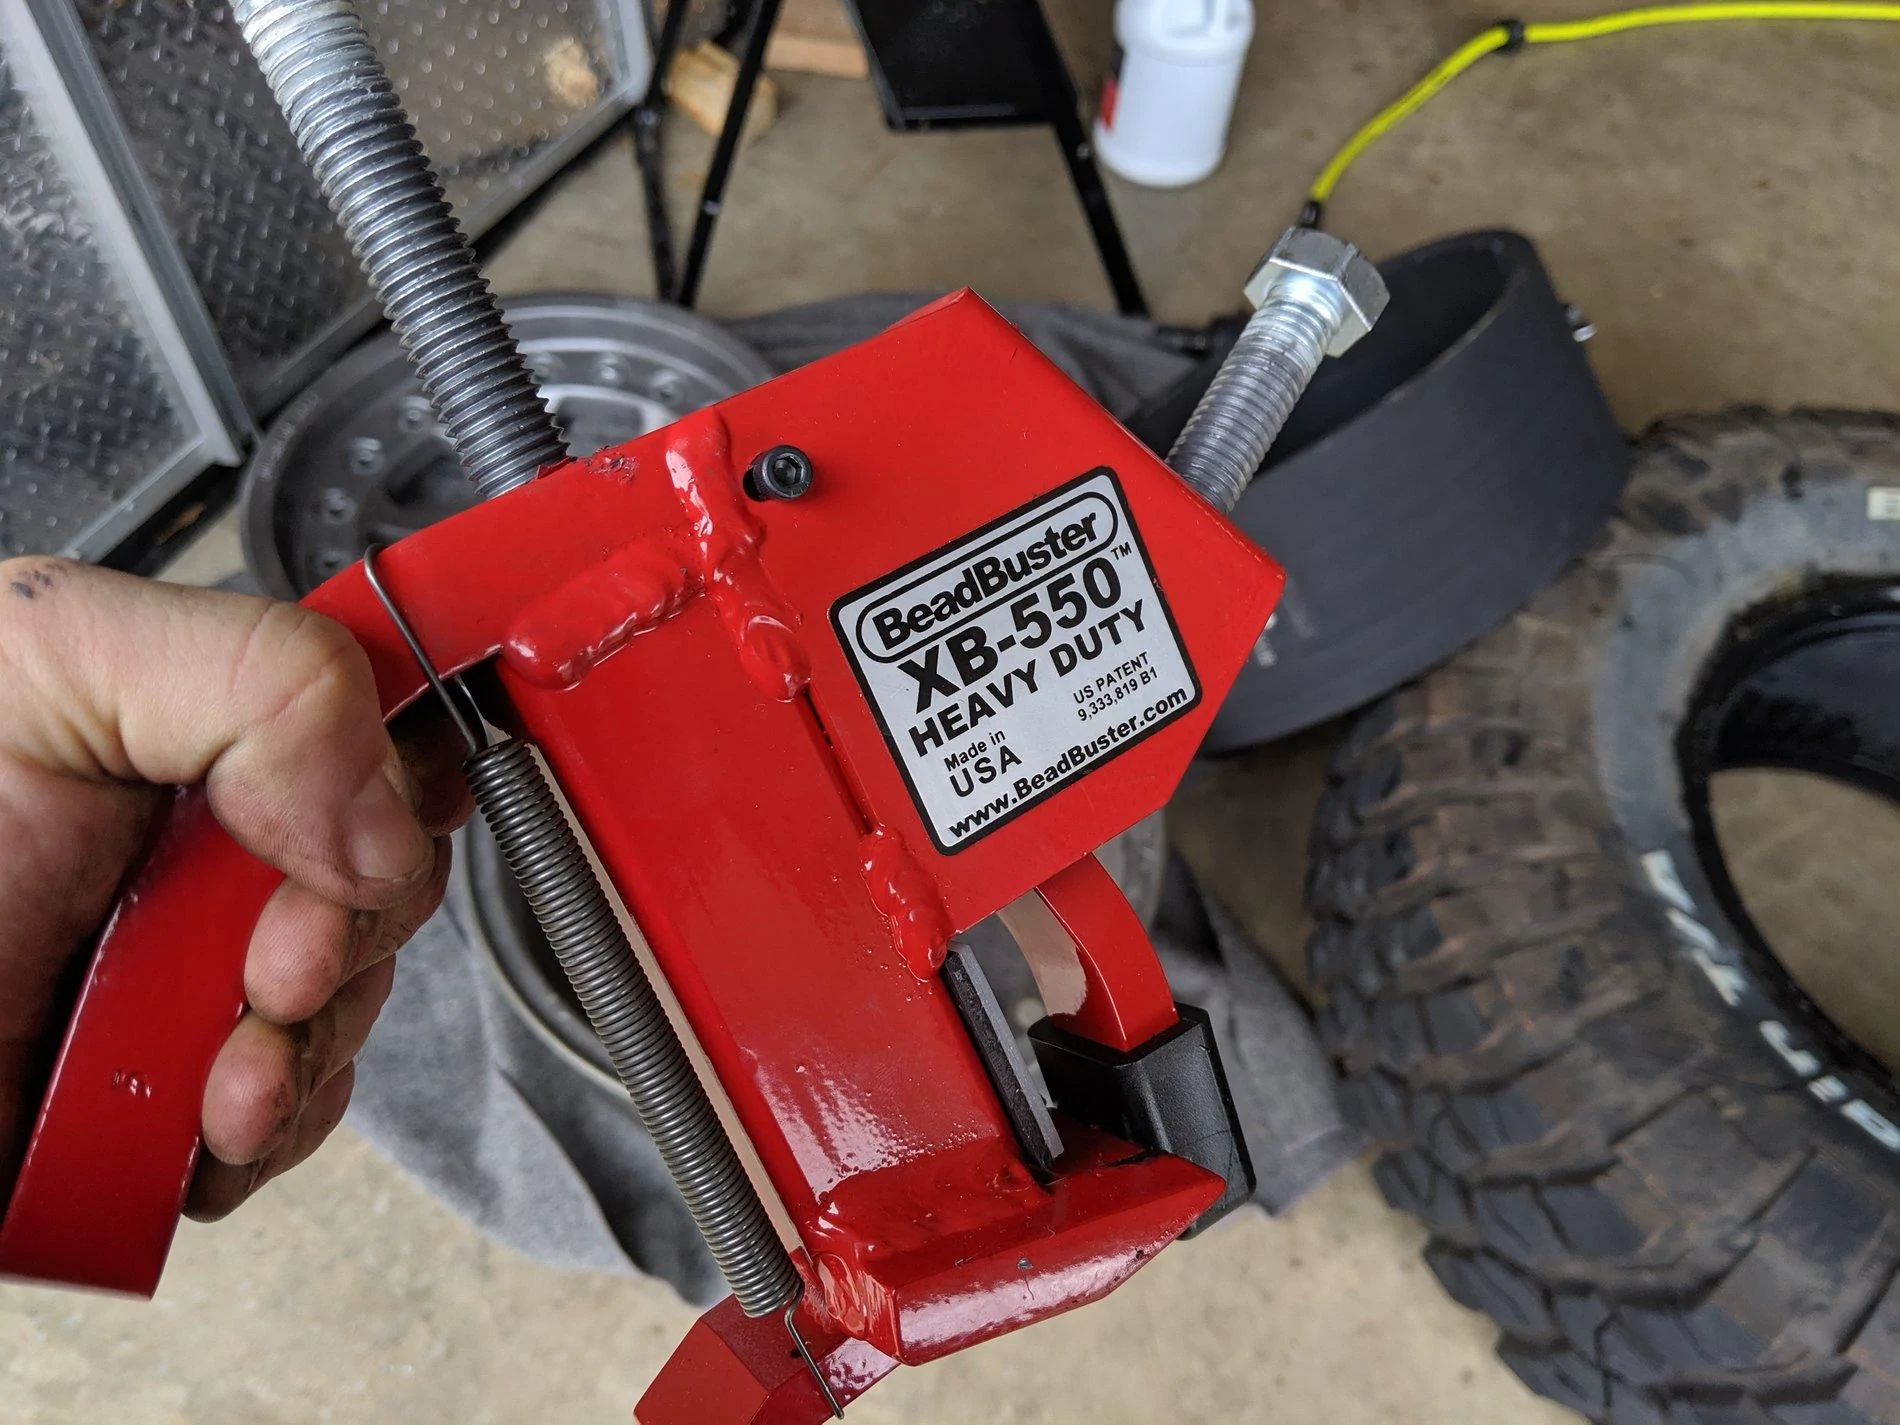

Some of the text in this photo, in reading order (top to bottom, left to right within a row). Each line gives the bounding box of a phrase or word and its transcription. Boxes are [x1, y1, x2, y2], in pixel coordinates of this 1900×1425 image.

[872, 512, 1098, 650] BeadBuster
[898, 557, 1122, 714] XB-550
[908, 599, 1147, 757] HEAVY DUTY
[1073, 652, 1149, 704] US PATENT
[1078, 667, 1158, 722] 9,333,819 B1
[944, 730, 1006, 771] Made in
[949, 687, 1188, 838] www.BeadBuster.com
[949, 745, 1022, 797] USA
